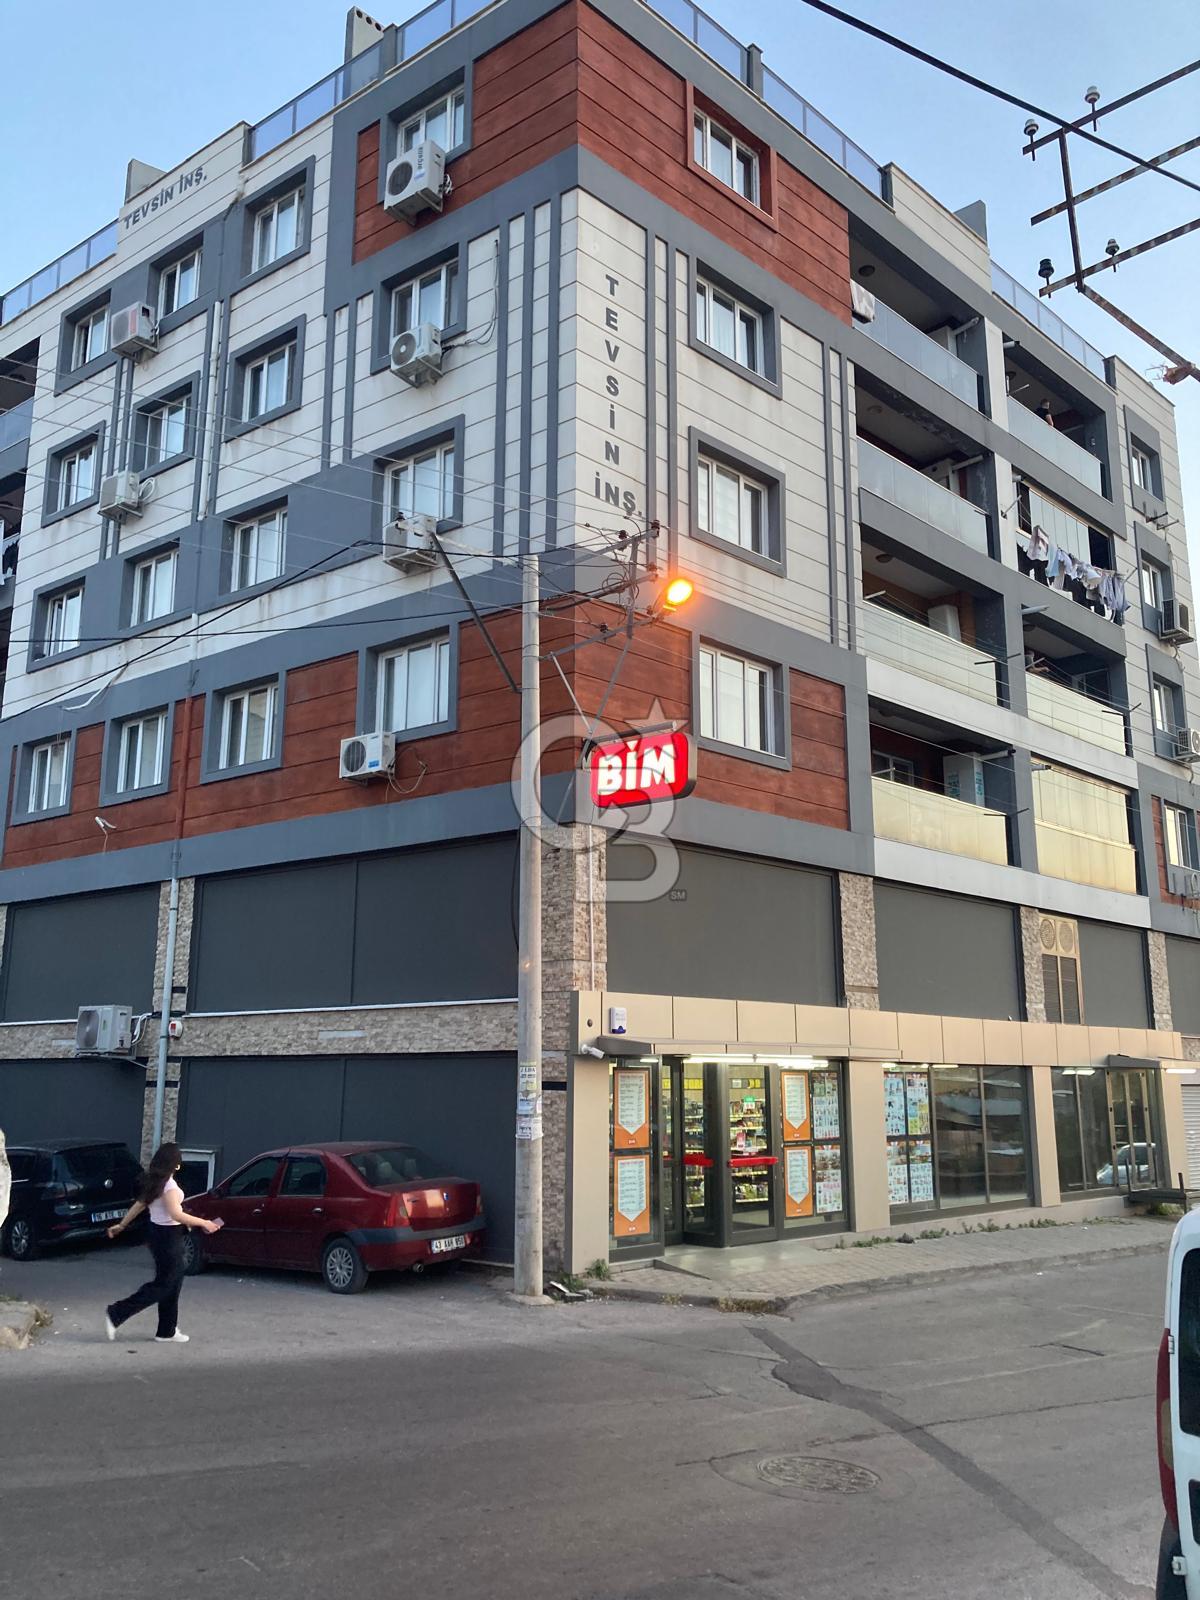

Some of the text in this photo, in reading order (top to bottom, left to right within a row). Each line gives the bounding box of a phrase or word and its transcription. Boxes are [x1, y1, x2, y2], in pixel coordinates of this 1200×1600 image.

[122, 187, 174, 230] TEVSİN
[604, 273, 621, 466] TEVSİN
[597, 740, 676, 796] BİM
